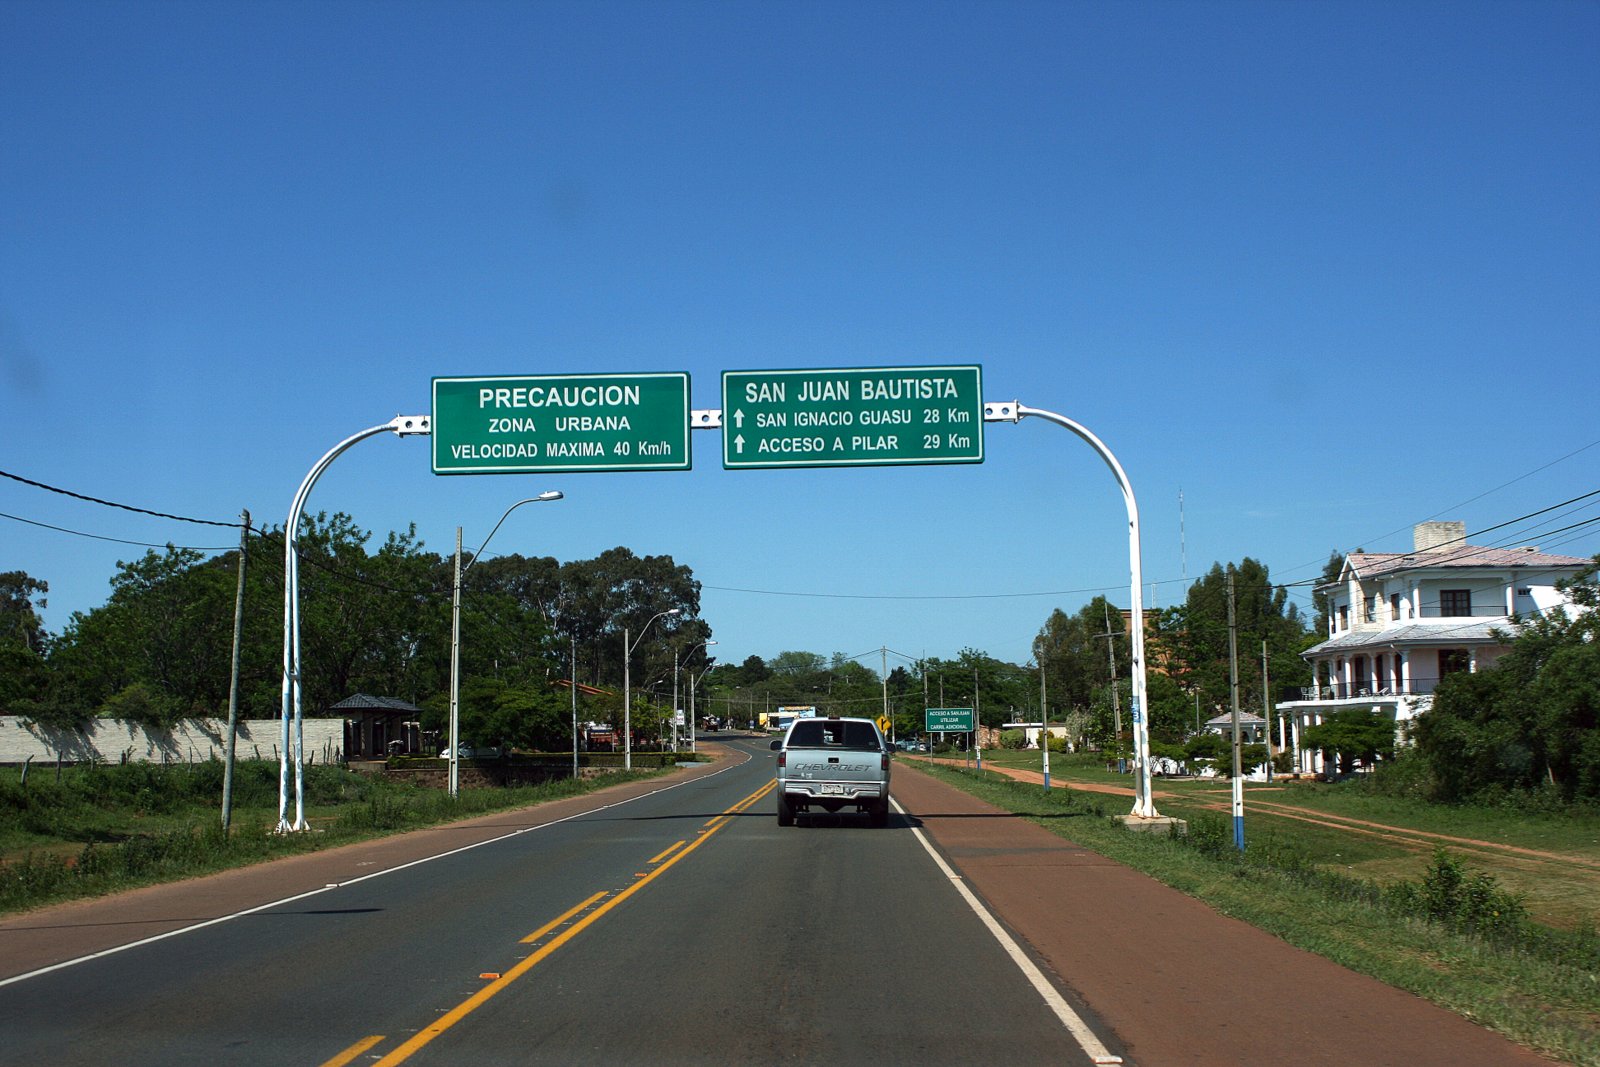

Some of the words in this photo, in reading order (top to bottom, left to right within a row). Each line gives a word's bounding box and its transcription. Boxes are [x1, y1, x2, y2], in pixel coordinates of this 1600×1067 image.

[479, 385, 640, 409] PRECAUCION
[745, 382, 786, 403] SAN
[797, 380, 850, 402] JUAN
[861, 378, 958, 401] BAUTISTA
[488, 417, 536, 433] ZONA
[555, 416, 631, 432] URBANA
[756, 412, 787, 428] SAN
[794, 410, 853, 426] IGNACIO
[860, 409, 912, 425] GUASU
[923, 409, 940, 424] 28
[948, 408, 970, 423] Km
[451, 443, 538, 459] VELOCIDAD
[546, 441, 604, 457] MAXIMA
[613, 441, 631, 456] 40
[639, 440, 671, 456] Km/h
[758, 437, 825, 453] ACCESO
[832, 436, 844, 451] A
[852, 436, 899, 451] PILAR
[923, 434, 941, 449] 29
[948, 434, 970, 449] Km
[794, 763, 873, 772] CHEVROLET
